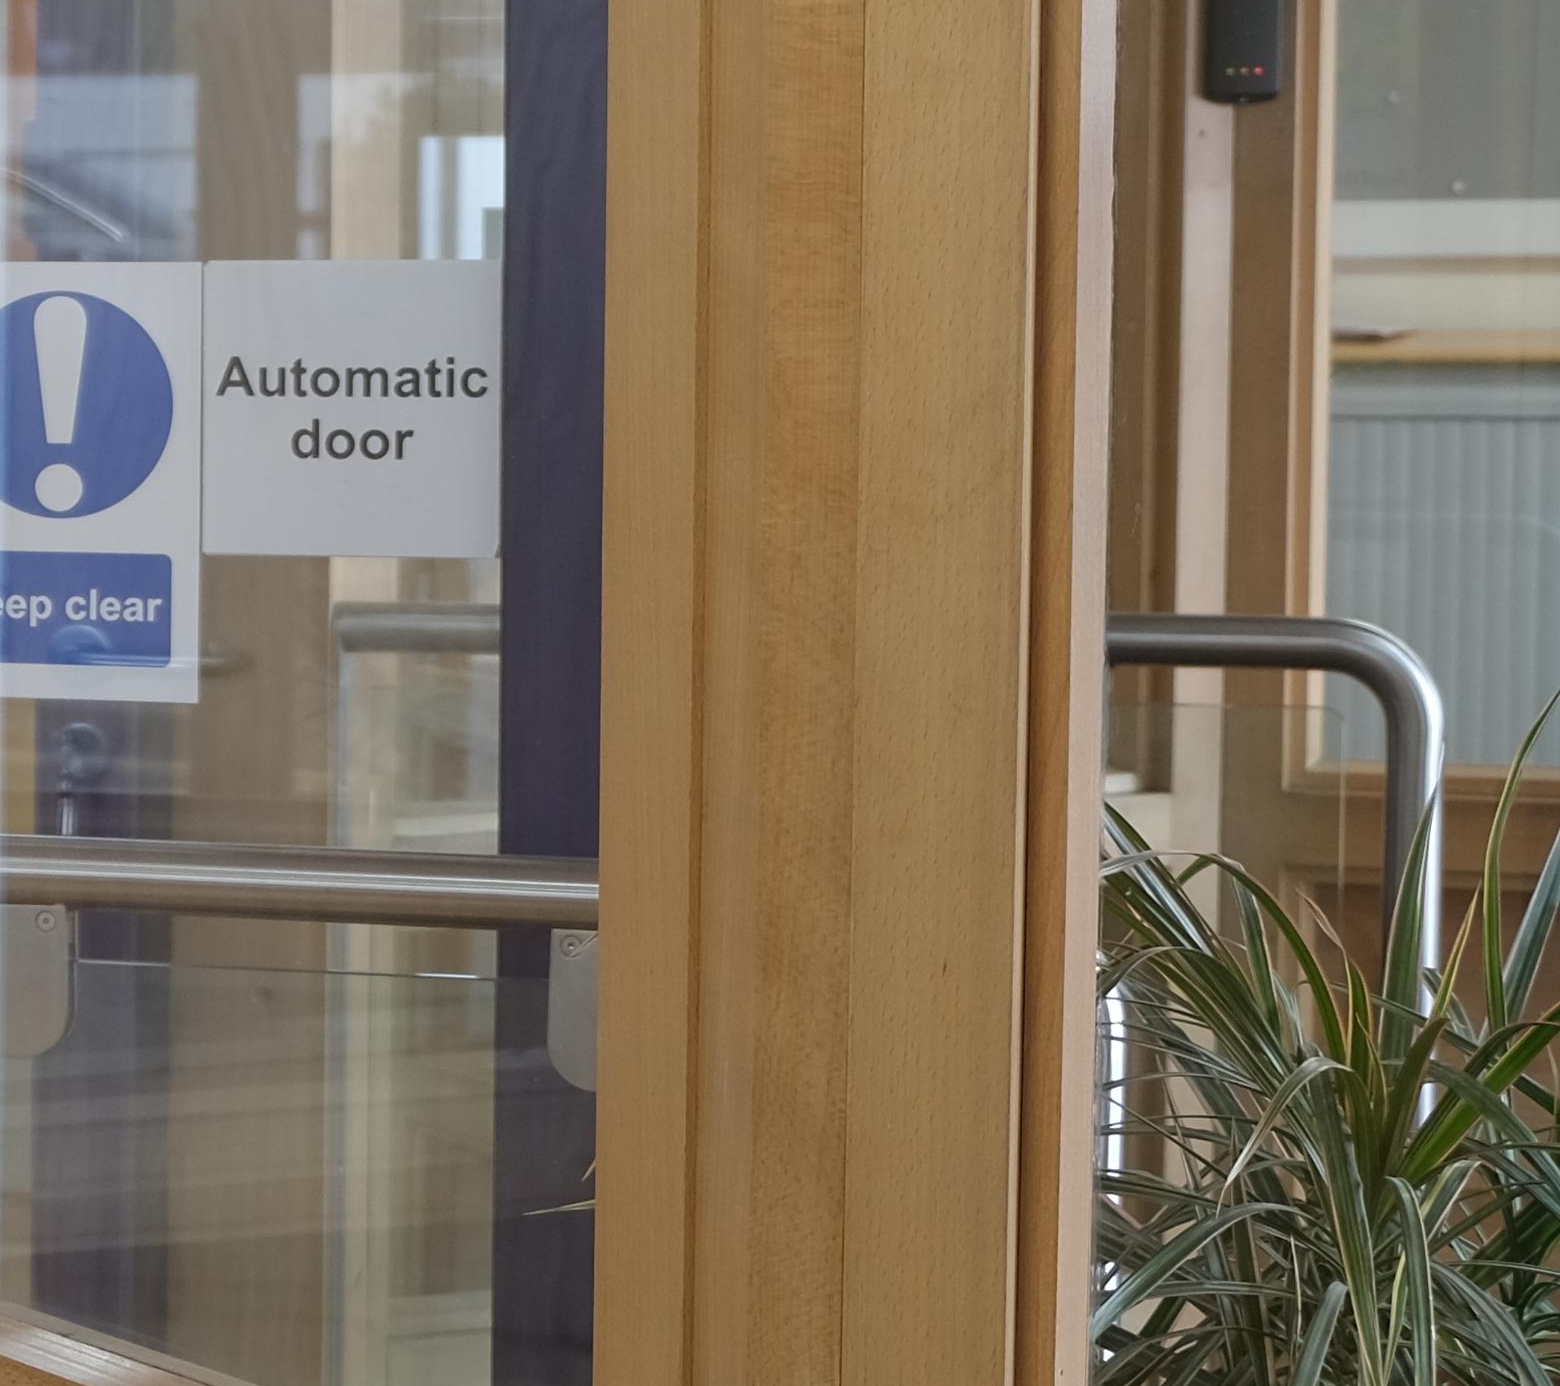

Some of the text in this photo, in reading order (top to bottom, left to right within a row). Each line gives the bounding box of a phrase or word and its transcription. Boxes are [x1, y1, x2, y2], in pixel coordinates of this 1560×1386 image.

[215, 356, 488, 398] Automatic
[291, 418, 414, 460] door
[64, 589, 163, 622] clear
